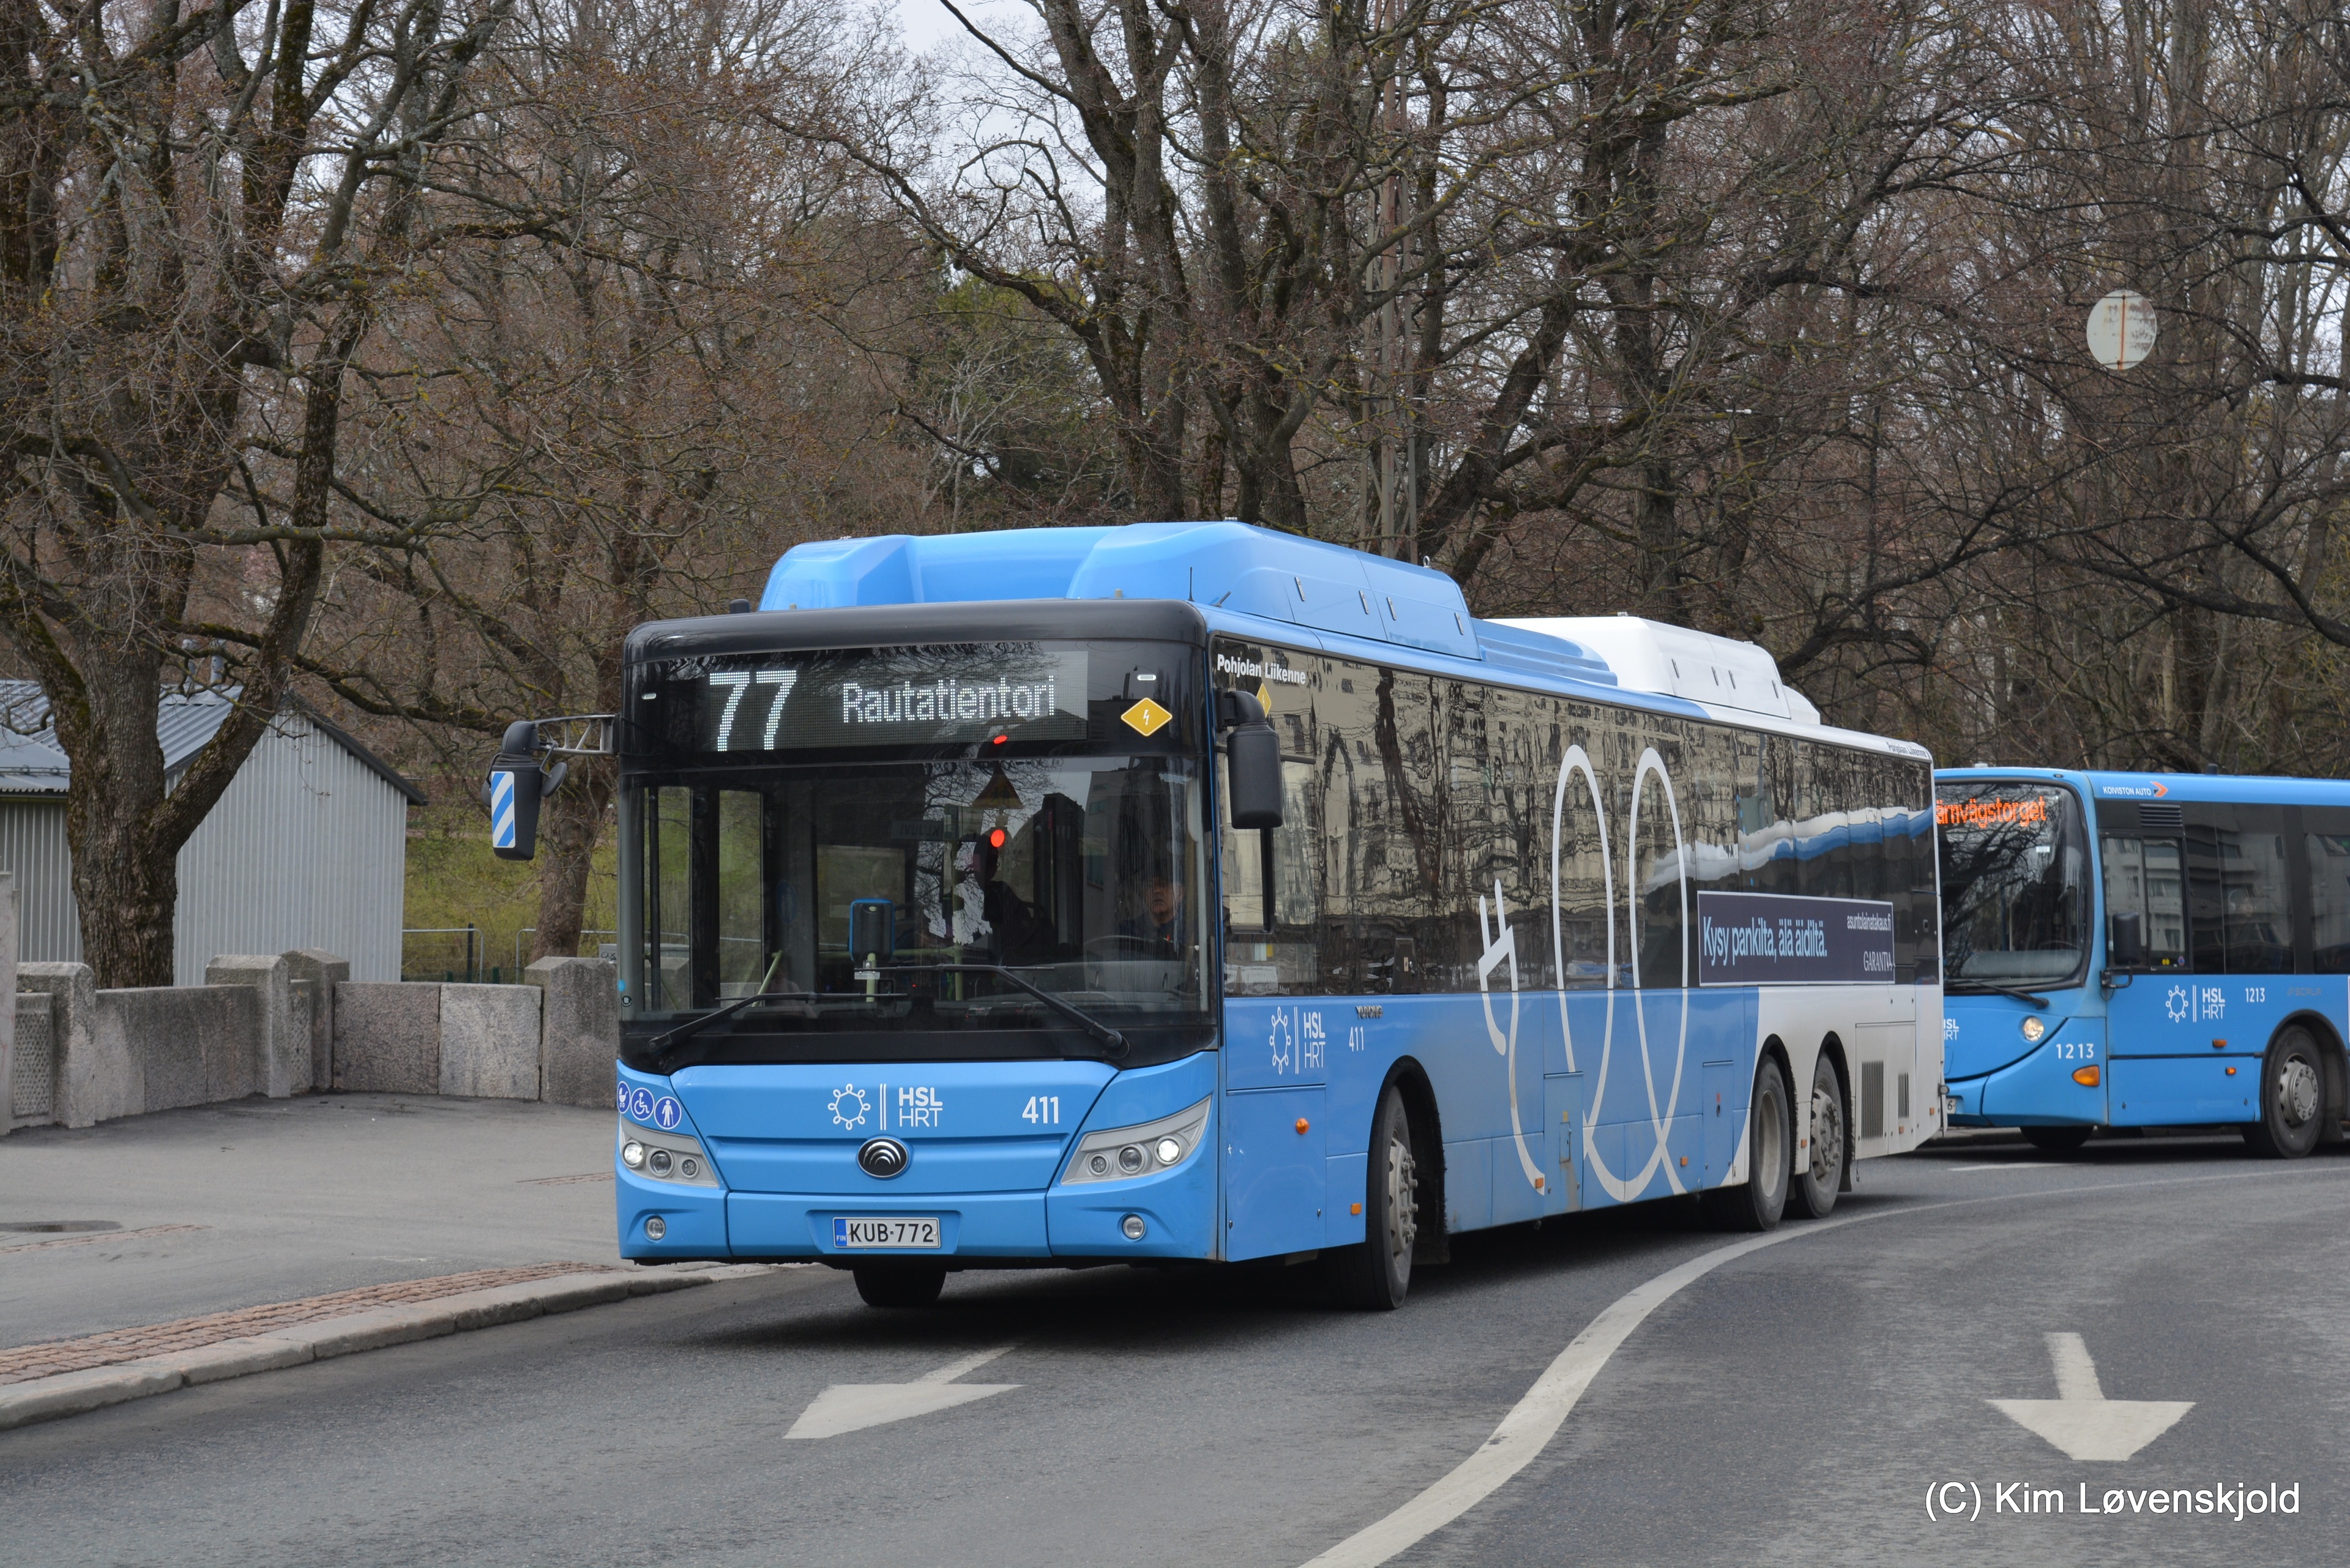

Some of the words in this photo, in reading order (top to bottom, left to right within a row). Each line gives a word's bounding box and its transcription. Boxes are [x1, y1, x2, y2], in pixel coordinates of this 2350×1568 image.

[1217, 654, 1262, 678] Pohjolan
[1265, 662, 1306, 685] Liikenne
[709, 670, 797, 752] 77
[842, 674, 1056, 723] Rautatientori
[2103, 786, 2135, 796] KOIVISTON
[2135, 788, 2152, 796] AUTO
[1936, 796, 2047, 829] ärnvägstorget
[1847, 911, 1892, 931] asuntolainatakaus.fi
[1703, 916, 1729, 966] Kysy
[1732, 917, 1777, 963] pankilta,
[1778, 918, 1794, 957] älä
[1796, 919, 1827, 957] äidiltä.
[1863, 950, 1893, 972] GARANTIA
[2202, 988, 2225, 1003] HSL
[2245, 988, 2266, 1002] 1213
[2295, 987, 2321, 996] SCALA
[1355, 1005, 1383, 1020] YUTONG
[2203, 1004, 2225, 1020] HRT
[1304, 1012, 1326, 1039] HSL
[1349, 1026, 1364, 1052] 411
[1304, 1042, 1326, 1069] HRT
[2056, 1043, 2094, 1059] 1213
[898, 1087, 943, 1107] HSL
[899, 1107, 943, 1127] HRT
[1021, 1096, 1059, 1124] 411
[849, 1223, 934, 1243] KUB-772
